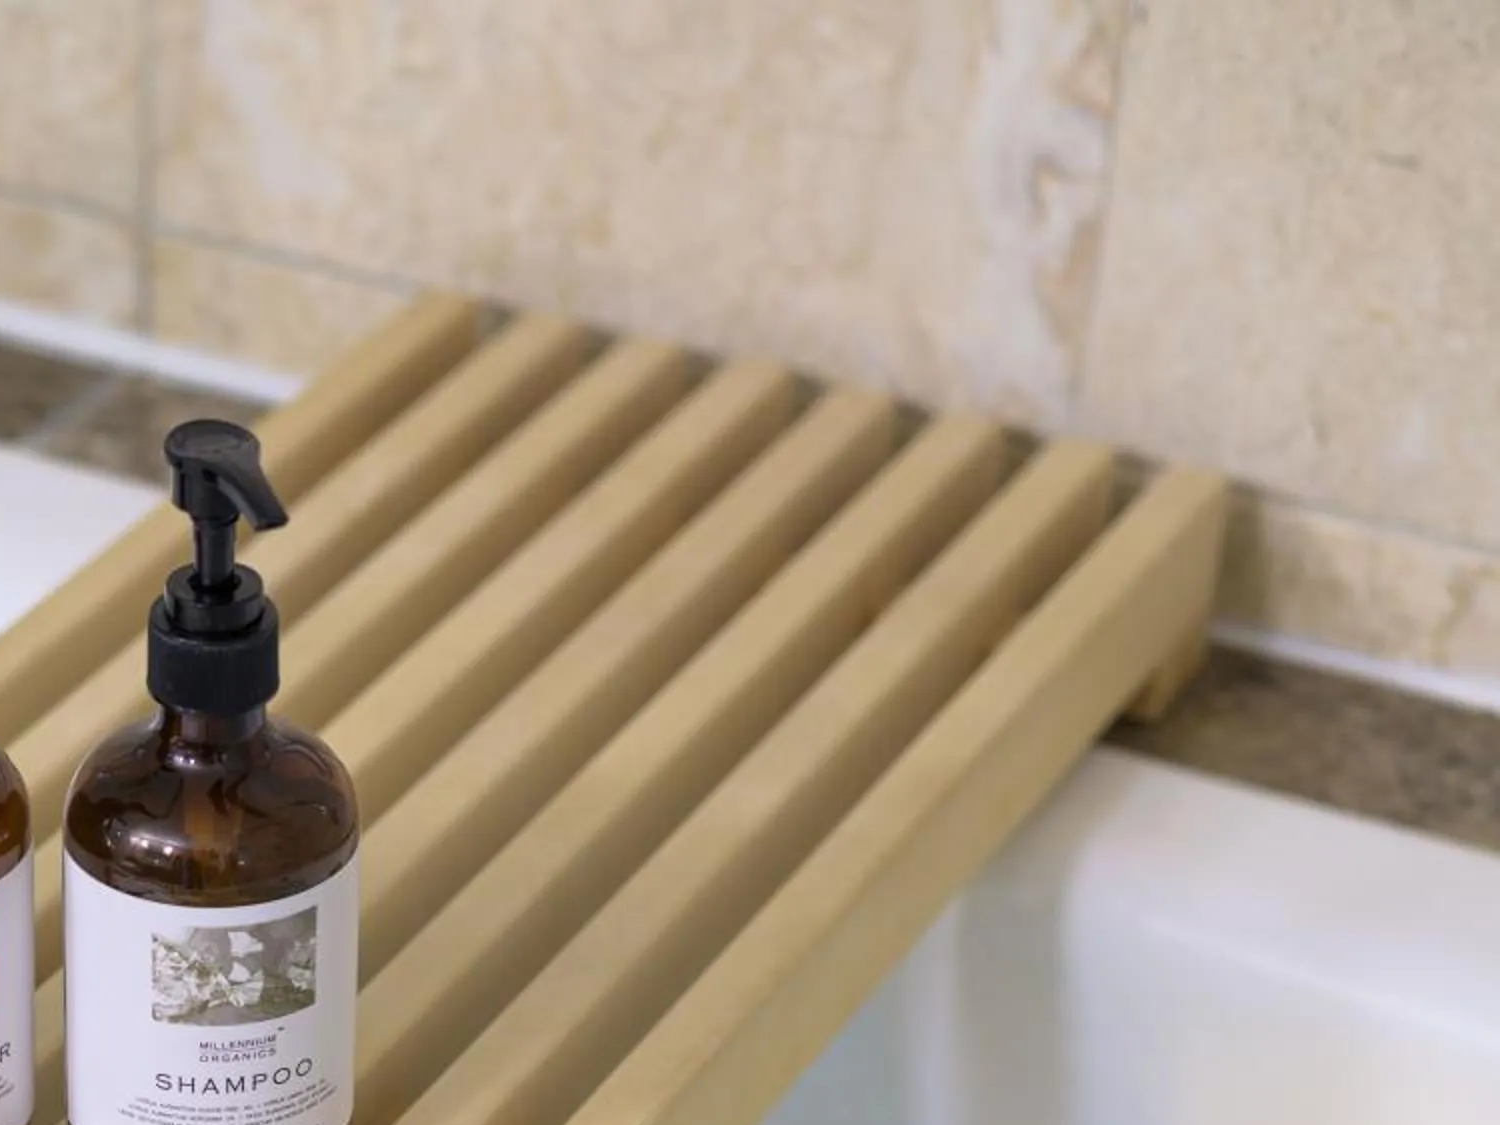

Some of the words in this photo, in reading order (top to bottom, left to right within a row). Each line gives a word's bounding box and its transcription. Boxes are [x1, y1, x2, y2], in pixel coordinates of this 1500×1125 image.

[199, 1034, 277, 1050] MILLENNIUM
[199, 1048, 277, 1063] ORGANICS
[155, 1058, 313, 1095] SHAMPOO
